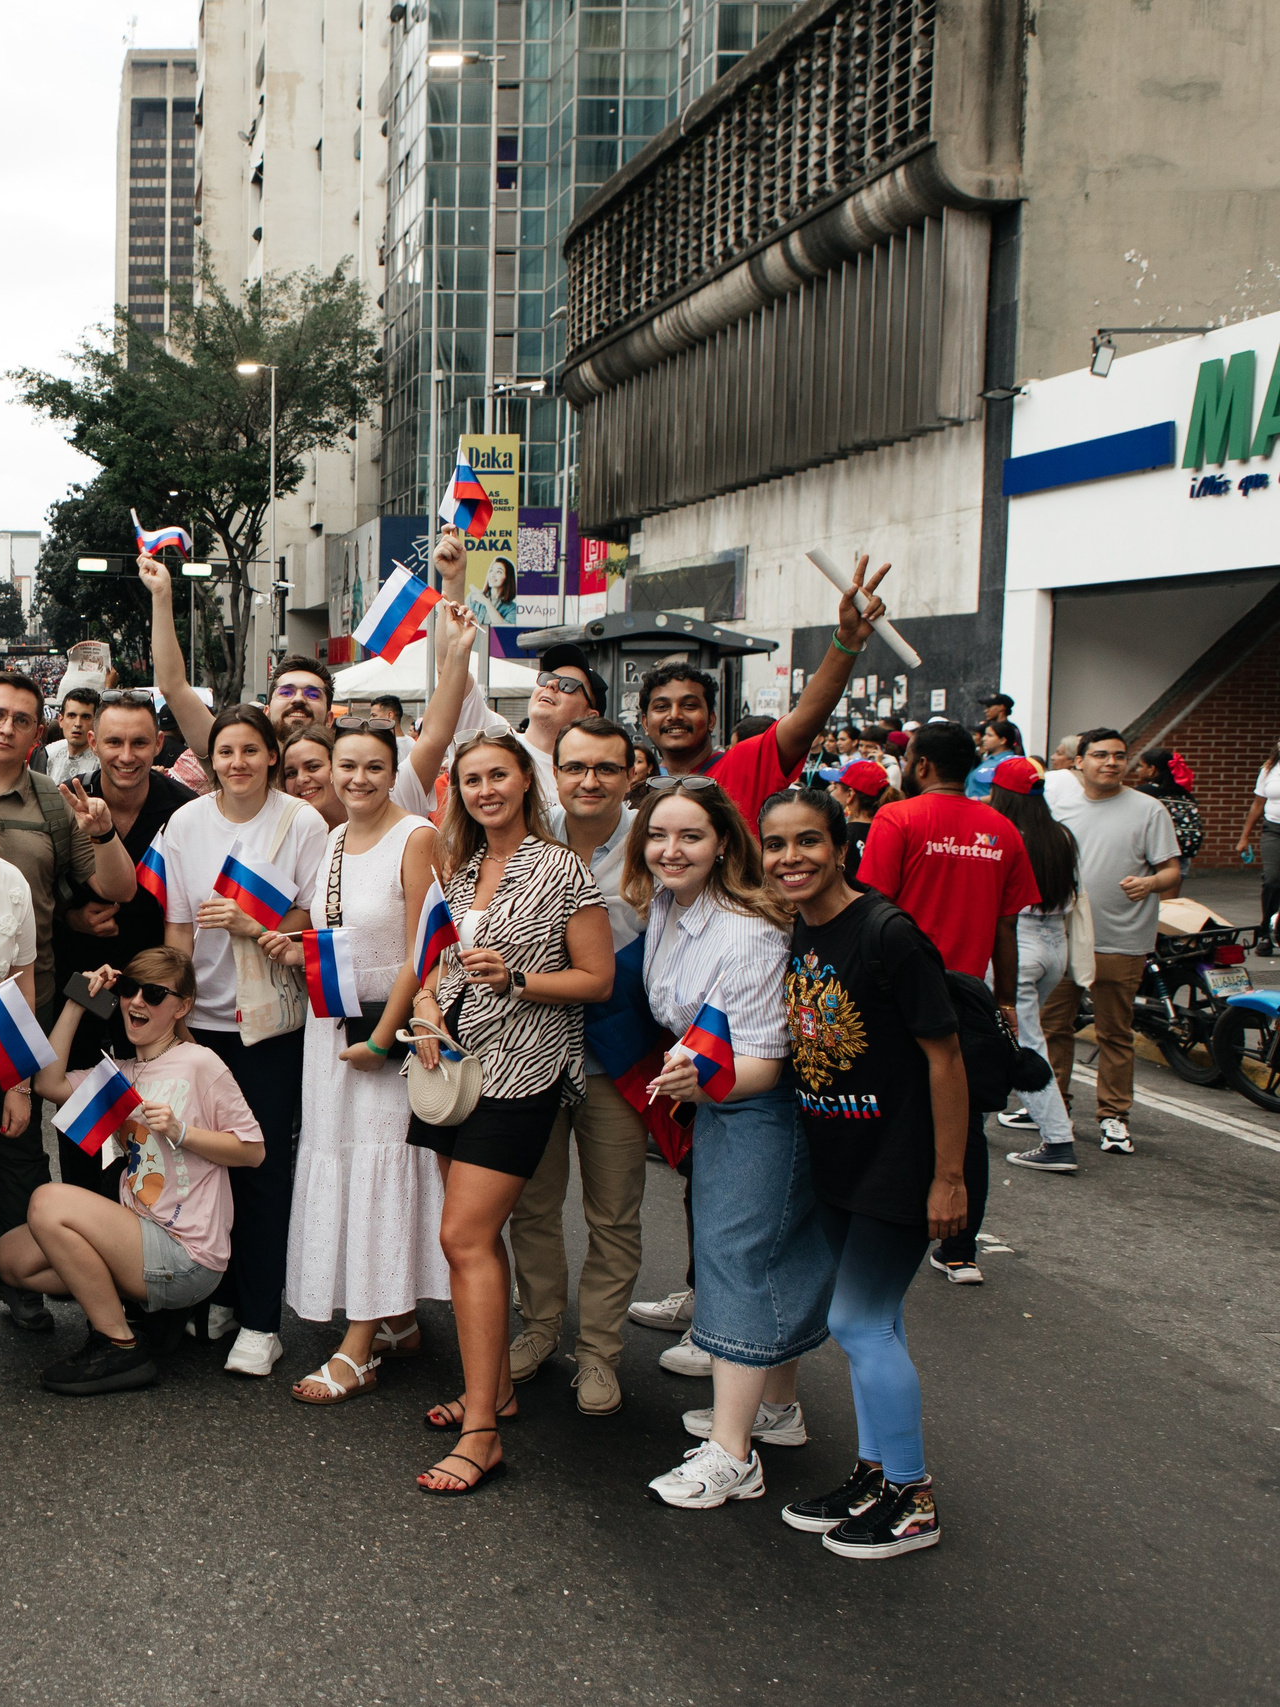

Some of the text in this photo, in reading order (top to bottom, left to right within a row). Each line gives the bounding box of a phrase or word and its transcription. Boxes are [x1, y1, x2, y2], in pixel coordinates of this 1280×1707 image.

[468, 446, 513, 469] Daka
[499, 530, 513, 538] EN
[464, 539, 513, 552] DAKA
[795, 1088, 882, 1119] ОССИЯ
